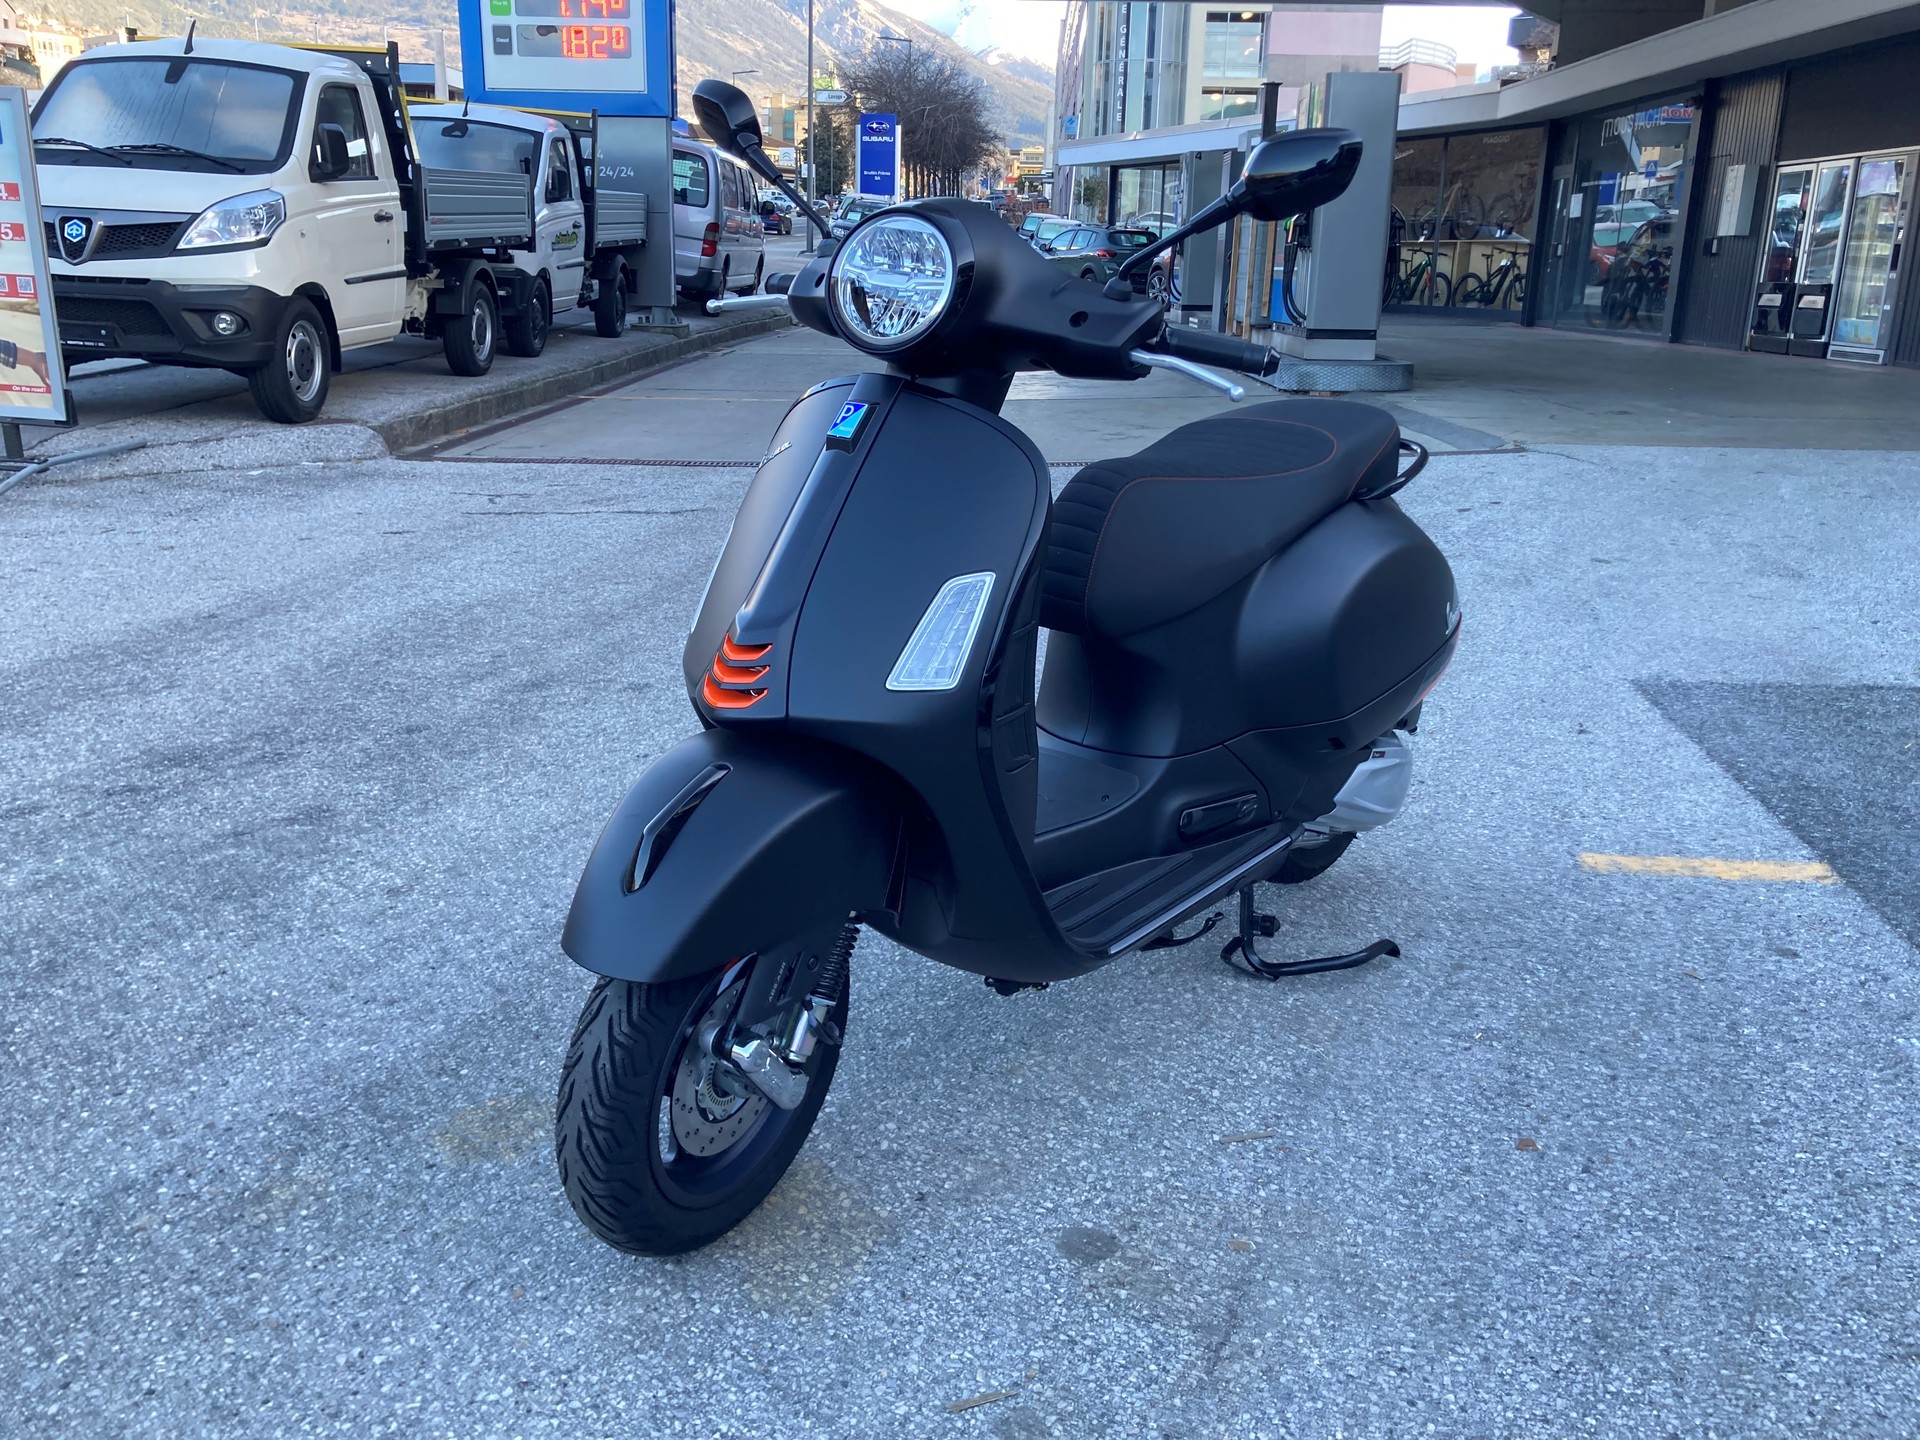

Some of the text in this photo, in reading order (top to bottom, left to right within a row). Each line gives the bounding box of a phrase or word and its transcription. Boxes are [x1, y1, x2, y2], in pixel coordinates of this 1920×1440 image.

[1116, 24, 1127, 121] GÉNÉRALE
[1483, 136, 1510, 144] PIAGGIO
[1195, 151, 1202, 160] 4
[600, 166, 634, 179] 24/24
